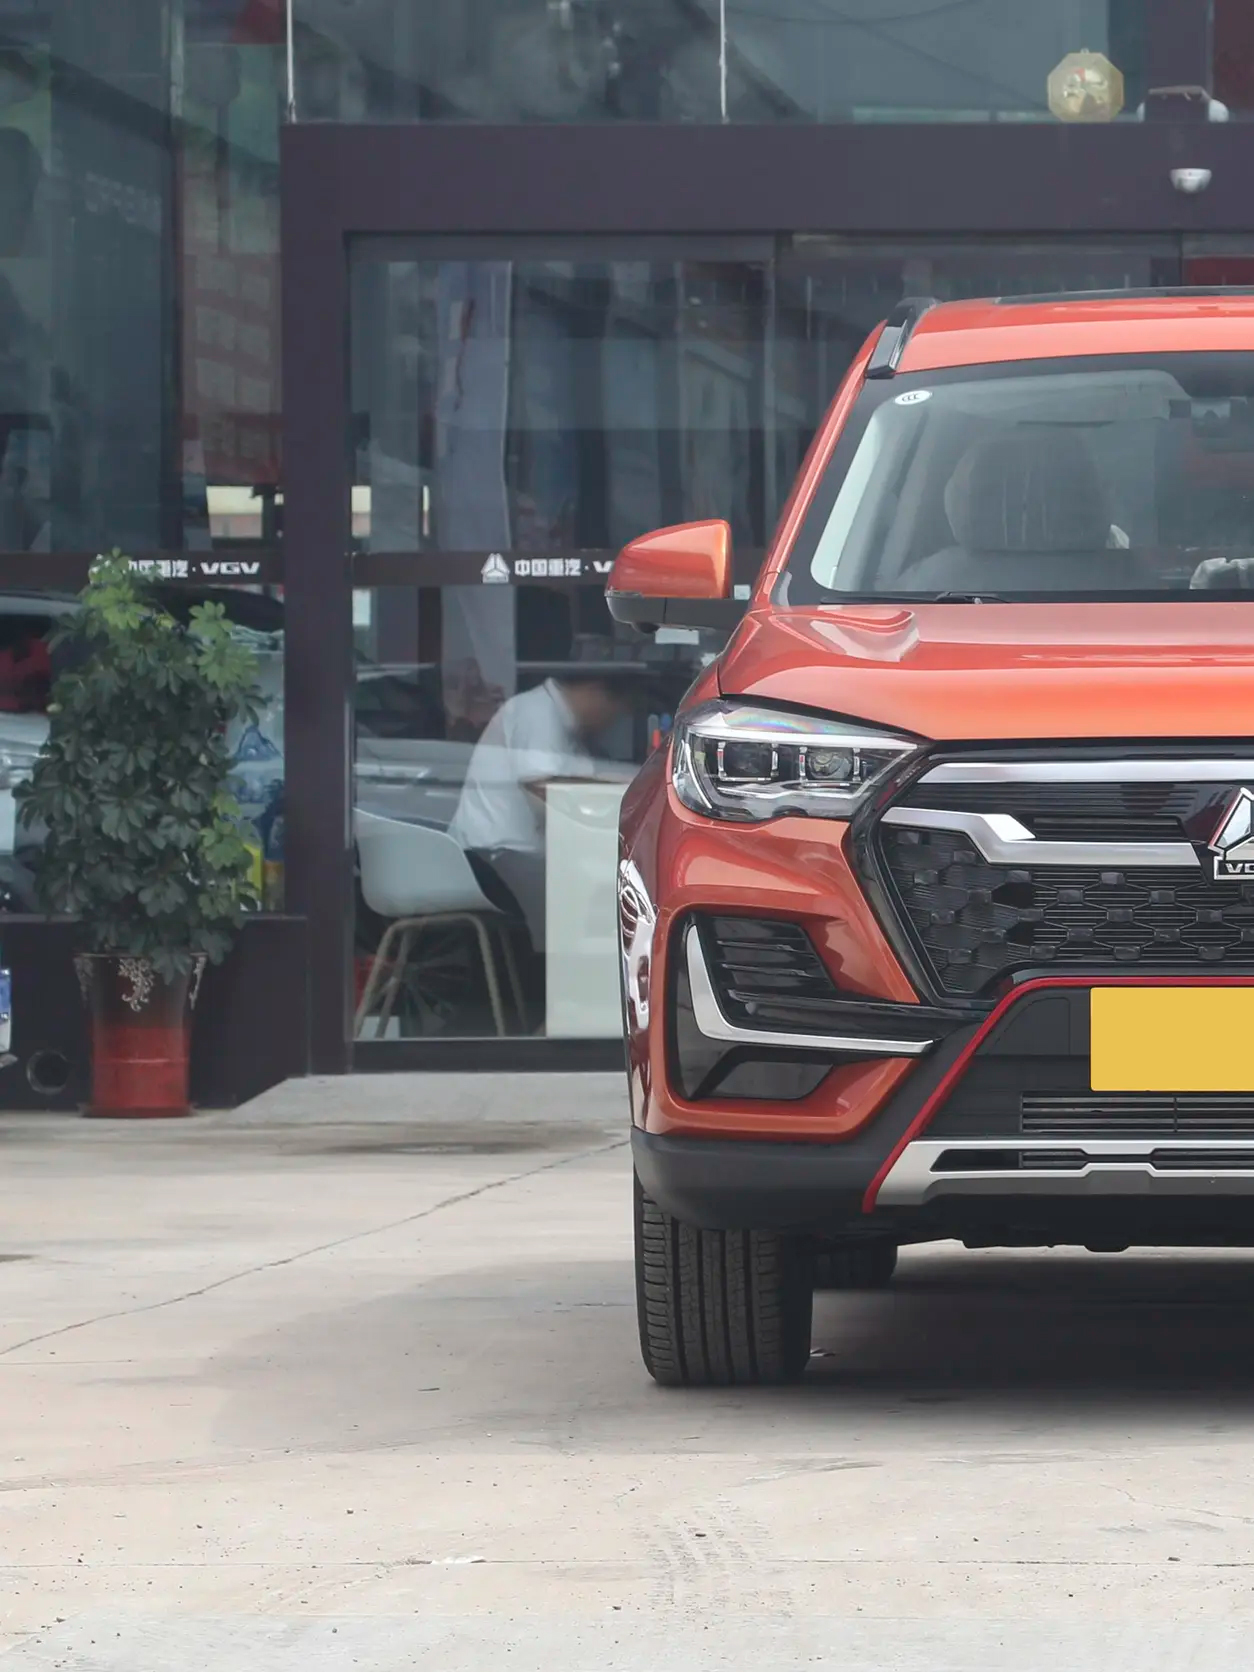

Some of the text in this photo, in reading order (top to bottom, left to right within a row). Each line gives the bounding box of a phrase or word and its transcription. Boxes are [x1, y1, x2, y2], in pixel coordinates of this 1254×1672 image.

[201, 562, 260, 575] VGV
[515, 558, 581, 577] 中国重汽
